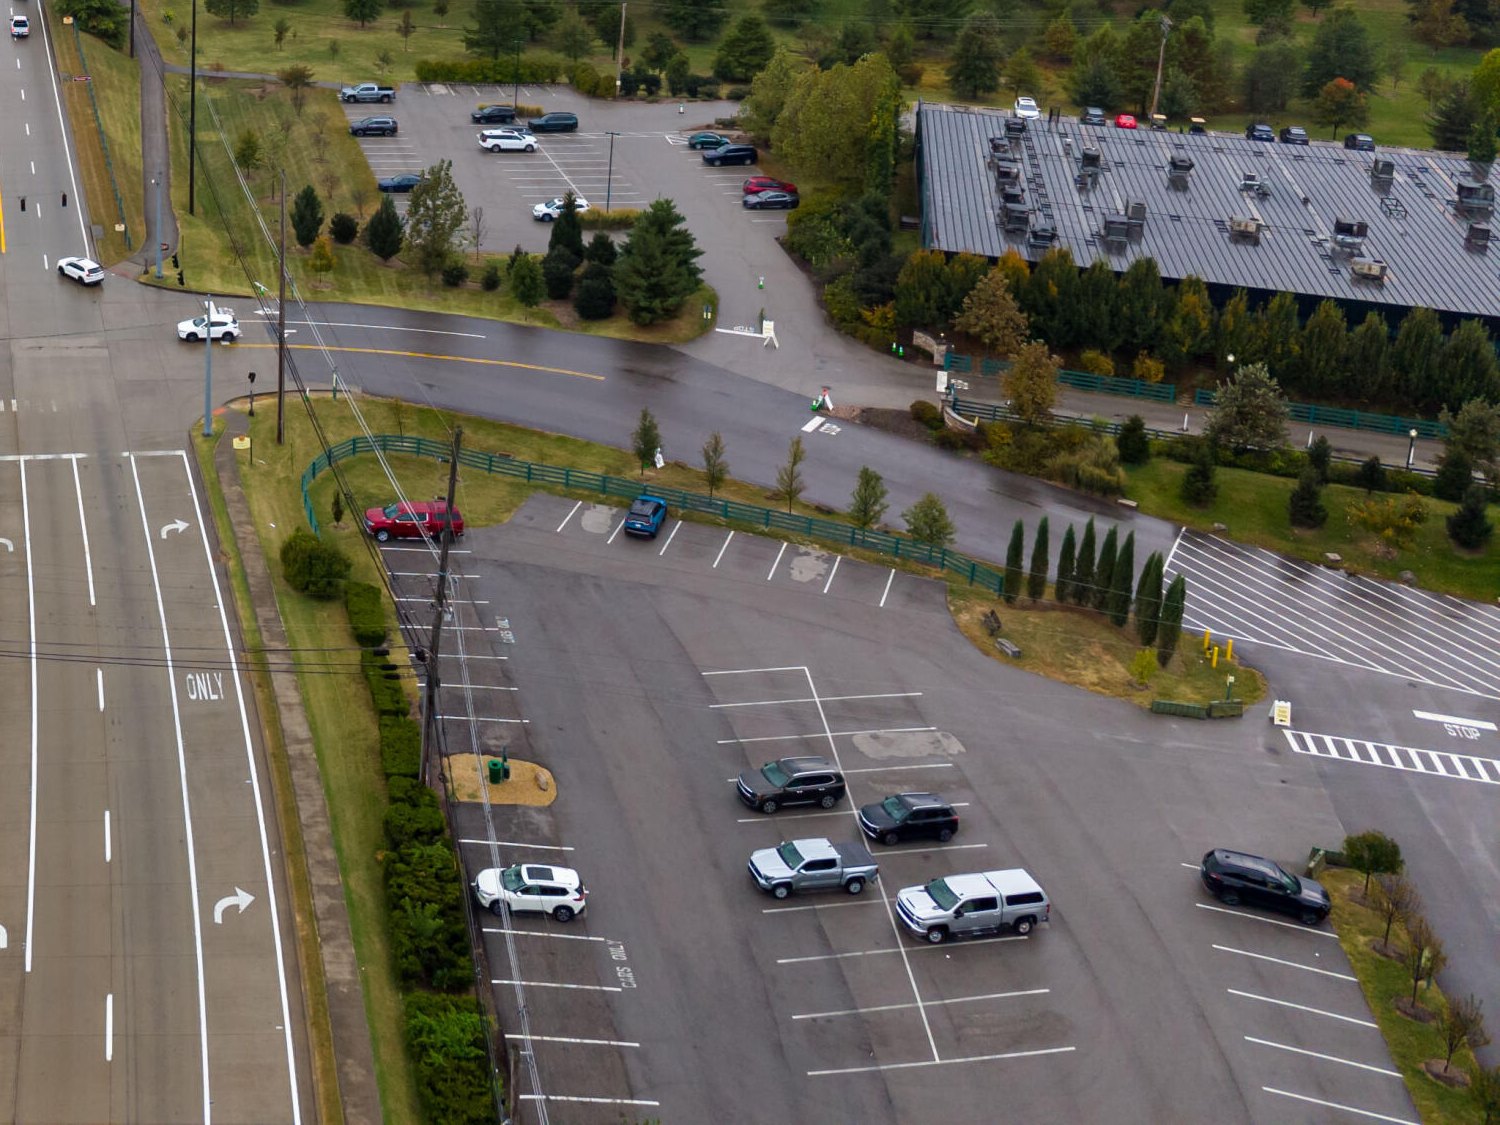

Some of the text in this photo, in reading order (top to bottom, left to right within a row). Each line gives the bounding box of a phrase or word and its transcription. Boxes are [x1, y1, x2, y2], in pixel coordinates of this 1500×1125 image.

[186, 672, 224, 700] ONLY
[1443, 723, 1481, 740] STOP
[606, 939, 637, 988] CARS ONLY
